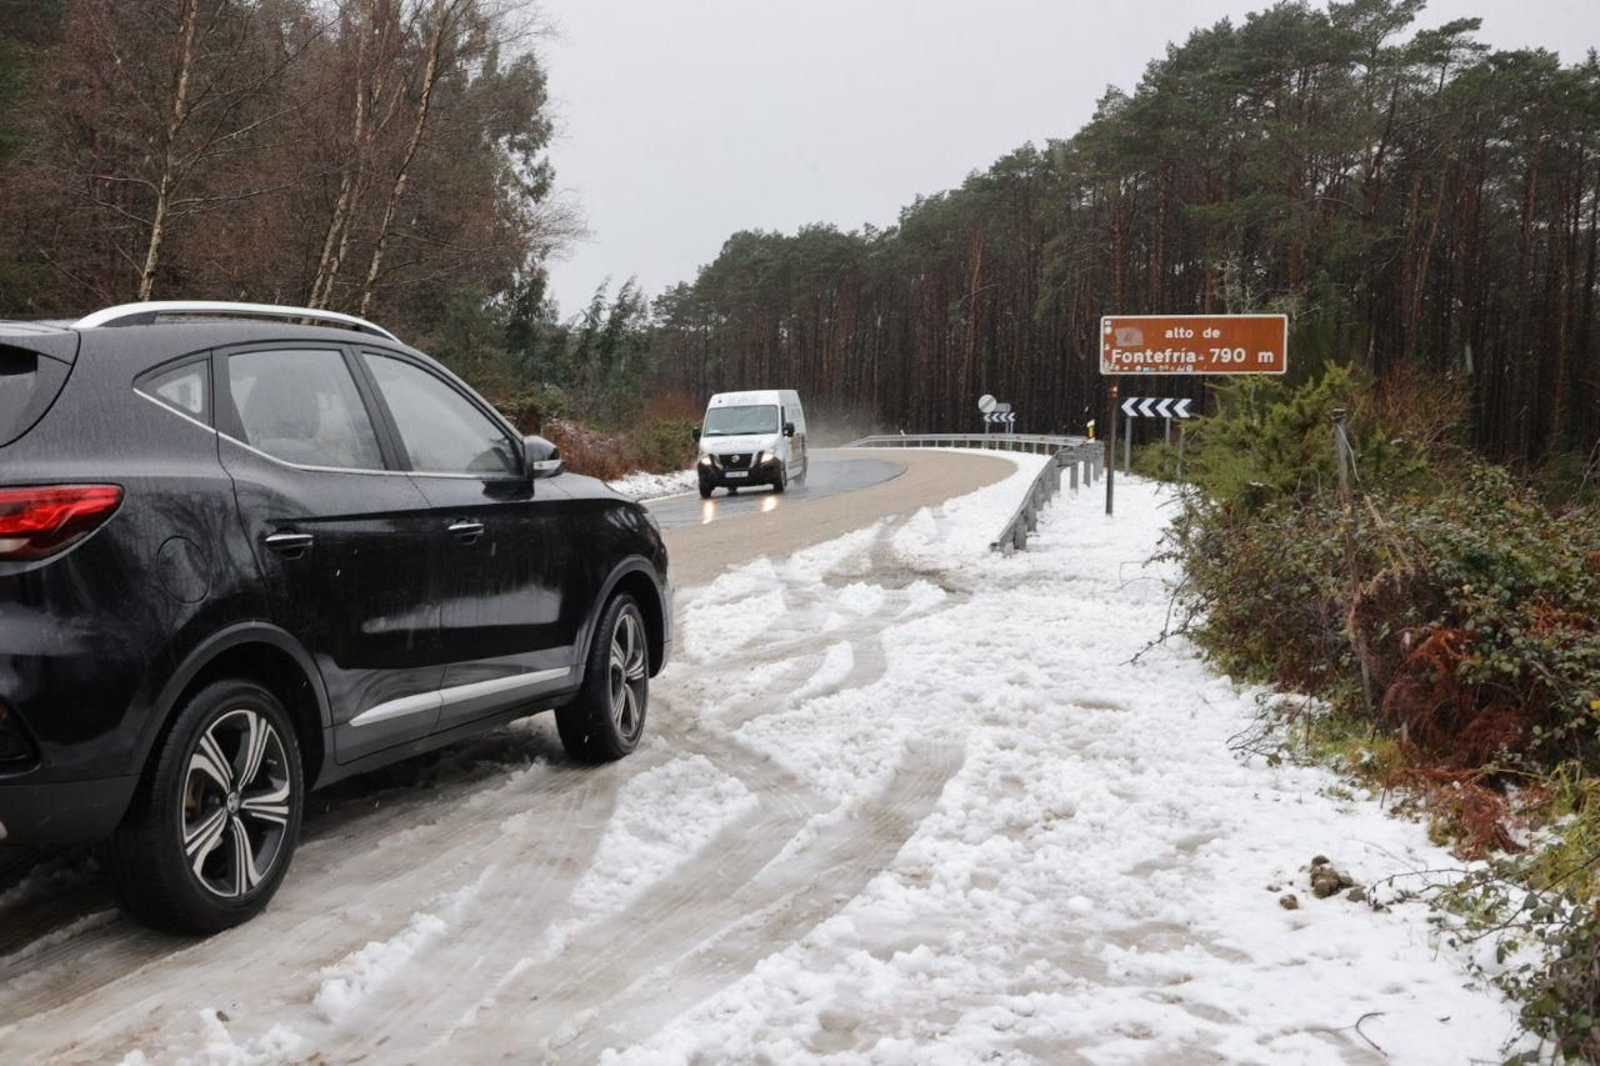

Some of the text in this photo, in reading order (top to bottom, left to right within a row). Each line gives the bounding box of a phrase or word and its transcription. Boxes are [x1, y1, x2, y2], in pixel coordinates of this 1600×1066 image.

[1165, 327, 1221, 338] alto de
[1209, 348, 1246, 363] 790
[1257, 351, 1274, 363] m
